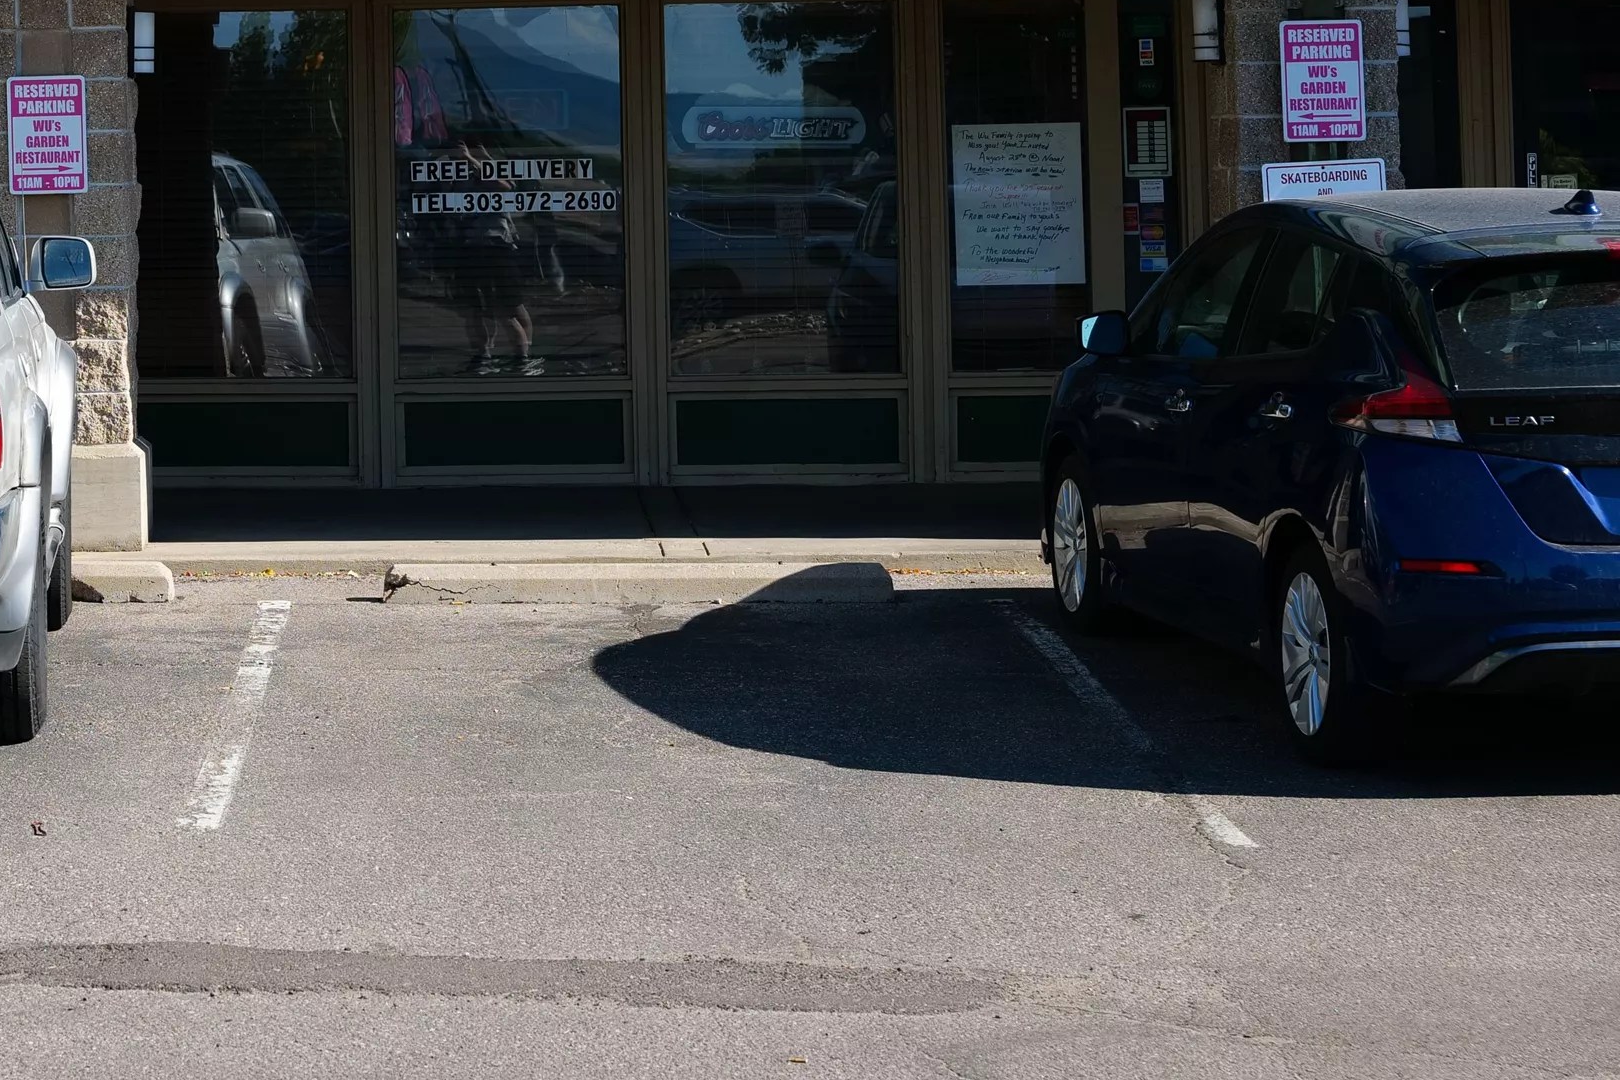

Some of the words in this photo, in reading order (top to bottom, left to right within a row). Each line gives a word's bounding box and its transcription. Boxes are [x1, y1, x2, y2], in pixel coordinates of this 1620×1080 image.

[1287, 28, 1355, 43] RESERVED
[1292, 44, 1352, 59] PARKING
[14, 84, 78, 98] RESERVED
[1300, 81, 1346, 94] GARDEN
[18, 100, 75, 114] PARKING
[1290, 97, 1358, 111] RESTAURANT
[770, 118, 852, 139] LIGHT
[1291, 124, 1318, 136] 11AM
[1329, 123, 1358, 136] 10PM
[26, 135, 69, 148] GARDEN
[16, 151, 80, 164] RESTAURANT
[412, 161, 468, 181] FREE
[482, 160, 593, 180] DELIVERY
[1280, 169, 1368, 185] SKATEBOARDING
[17, 176, 43, 188] 11AM
[53, 176, 80, 188] 10PM
[1317, 187, 1333, 196] AND
[414, 191, 616, 213] TEL.303-972-2690
[1489, 415, 1556, 427] LEAF
